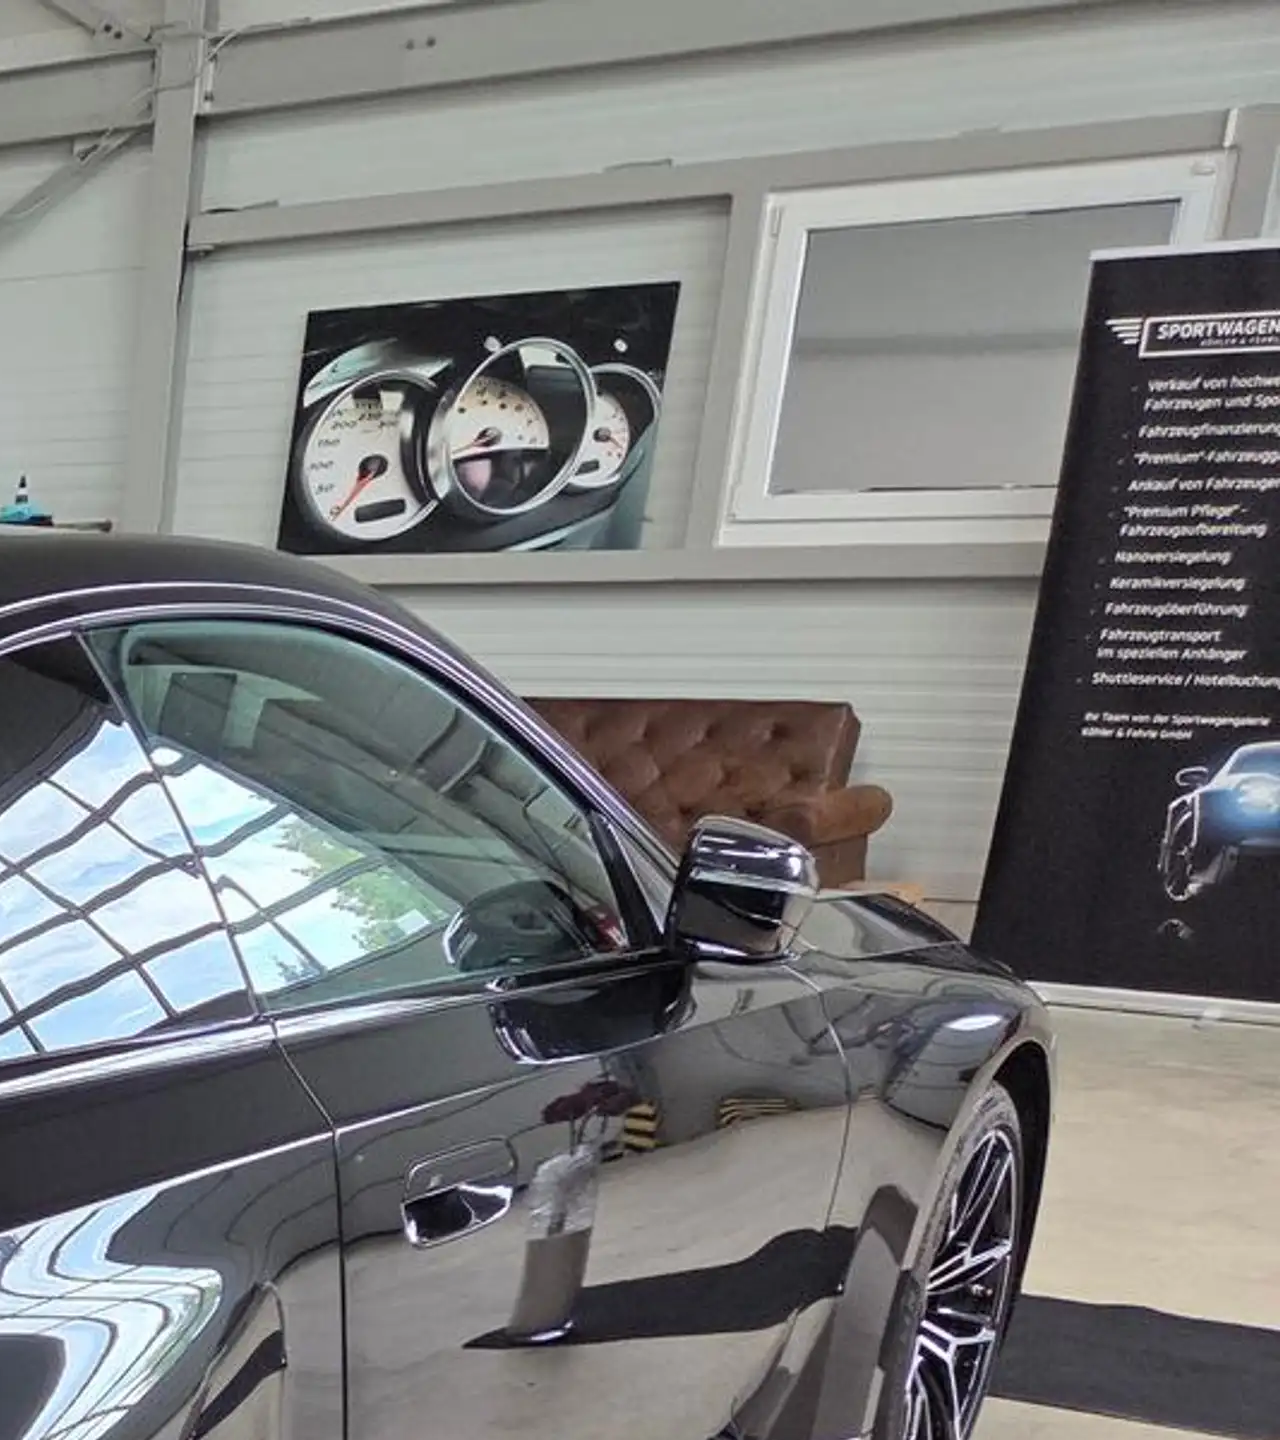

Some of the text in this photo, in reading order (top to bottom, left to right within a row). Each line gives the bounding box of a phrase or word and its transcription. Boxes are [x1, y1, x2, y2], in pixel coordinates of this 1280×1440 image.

[1156, 319, 1280, 340] SPORTWAGEN
[1202, 378, 1228, 390] von
[1143, 397, 1222, 412] Fahrzeugen
[1224, 394, 1252, 409] und
[1128, 477, 1179, 492] Ankauf
[1178, 480, 1205, 491] von
[1120, 522, 1268, 539] Fahrzeugaufbereitung
[1115, 550, 1233, 566] Nanoversiegelung
[1109, 576, 1246, 592] Keramikversiegelung
[1105, 602, 1248, 619] Fahrzeugüberführung
[1100, 628, 1222, 644] Fahrzeugtransport
[1116, 648, 1179, 662] speziellen
[1181, 648, 1248, 663] Anhänger
[1092, 671, 1184, 687] Shuttleservice
[1102, 712, 1130, 723] Team
[1131, 714, 1152, 724] von
